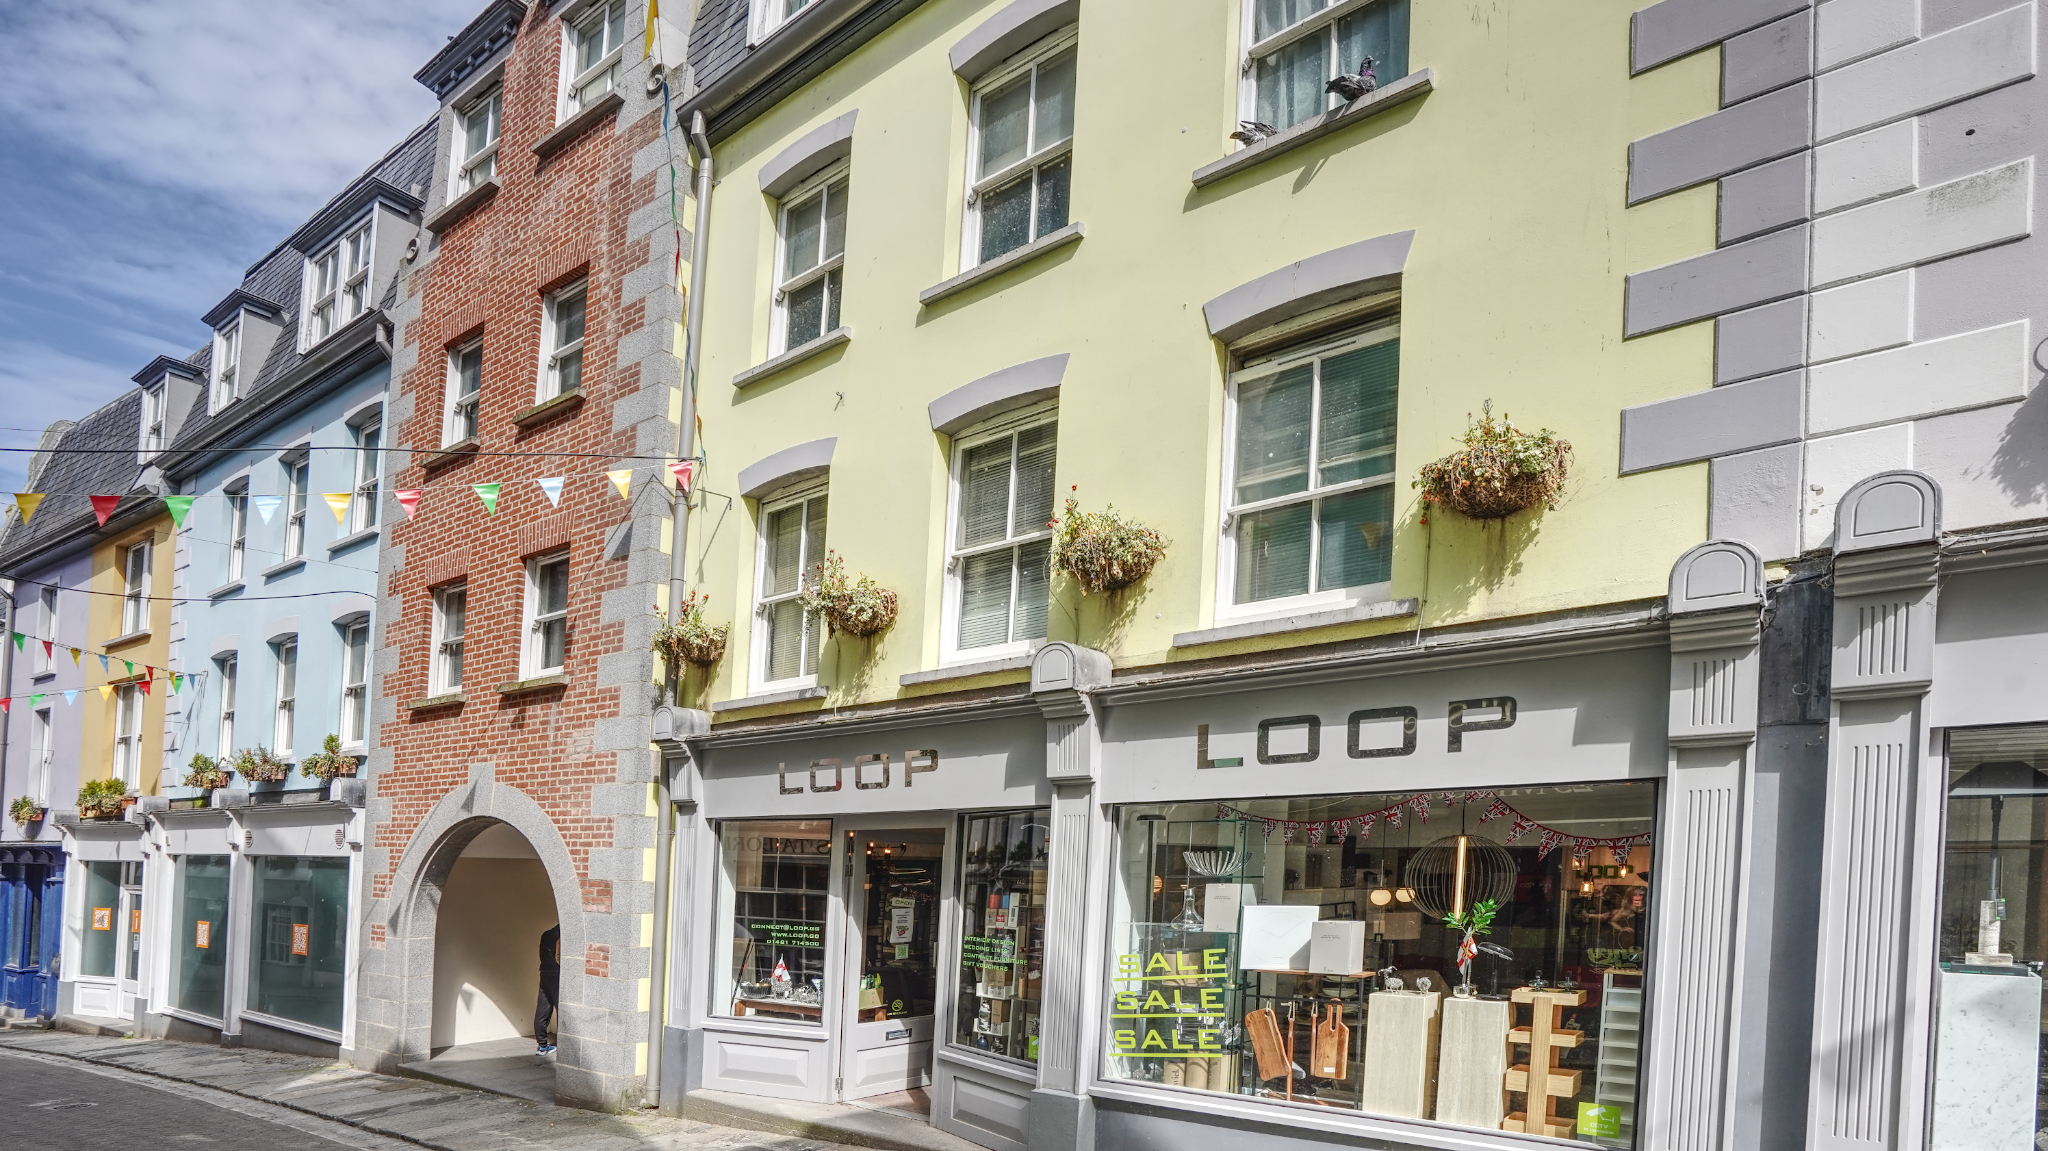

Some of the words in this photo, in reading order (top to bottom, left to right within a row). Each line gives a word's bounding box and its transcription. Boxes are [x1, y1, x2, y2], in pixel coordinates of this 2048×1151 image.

[1197, 696, 1517, 769] LOOP
[779, 749, 938, 795] LOOP
[976, 963, 1008, 971] VOUCHERS
[994, 956, 1028, 966] FURNITURE
[1119, 948, 1226, 974] SALE
[1116, 988, 1224, 1010] SALE
[1114, 1029, 1221, 1049] SALE
